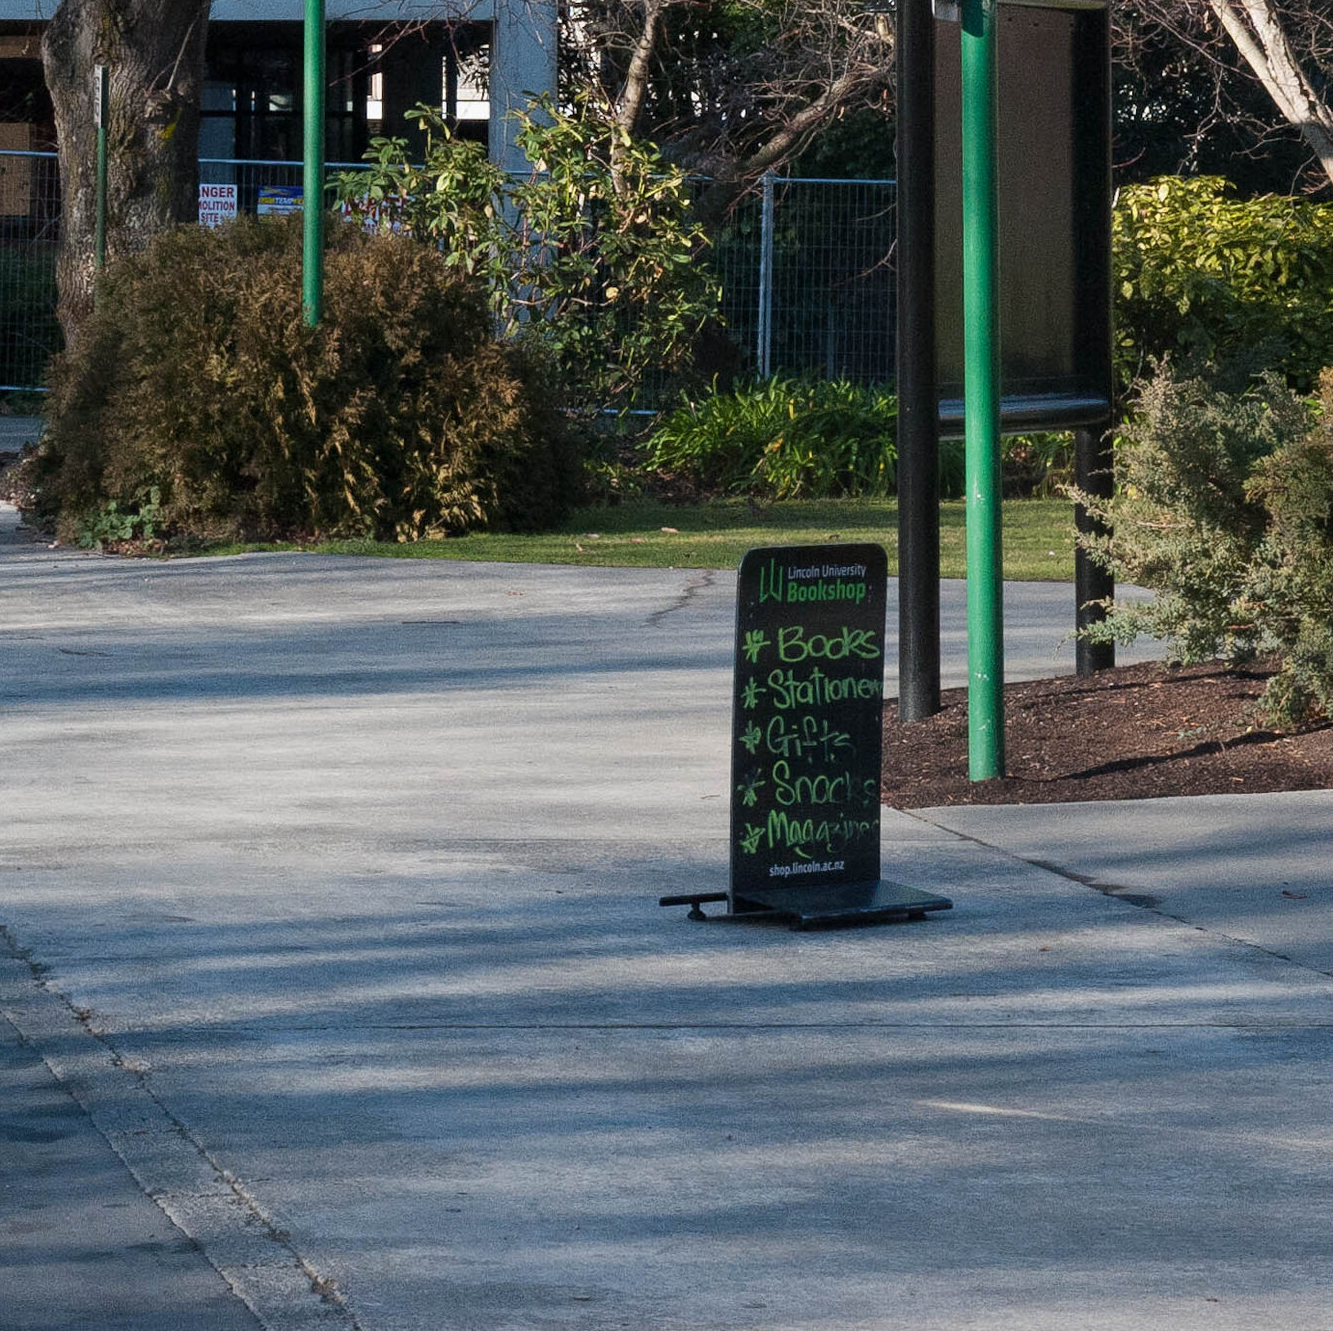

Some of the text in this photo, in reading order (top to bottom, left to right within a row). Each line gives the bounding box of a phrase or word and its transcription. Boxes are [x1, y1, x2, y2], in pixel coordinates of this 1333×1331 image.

[201, 186, 235, 198] NGER
[198, 201, 235, 211] OLITION
[201, 213, 219, 222] SITE
[788, 562, 867, 580] Lincoln University
[786, 578, 866, 605] Bookshop
[778, 625, 881, 663] Books
[767, 716, 855, 763] Gifts
[769, 860, 845, 878] shop.lincoln.ac.nz
